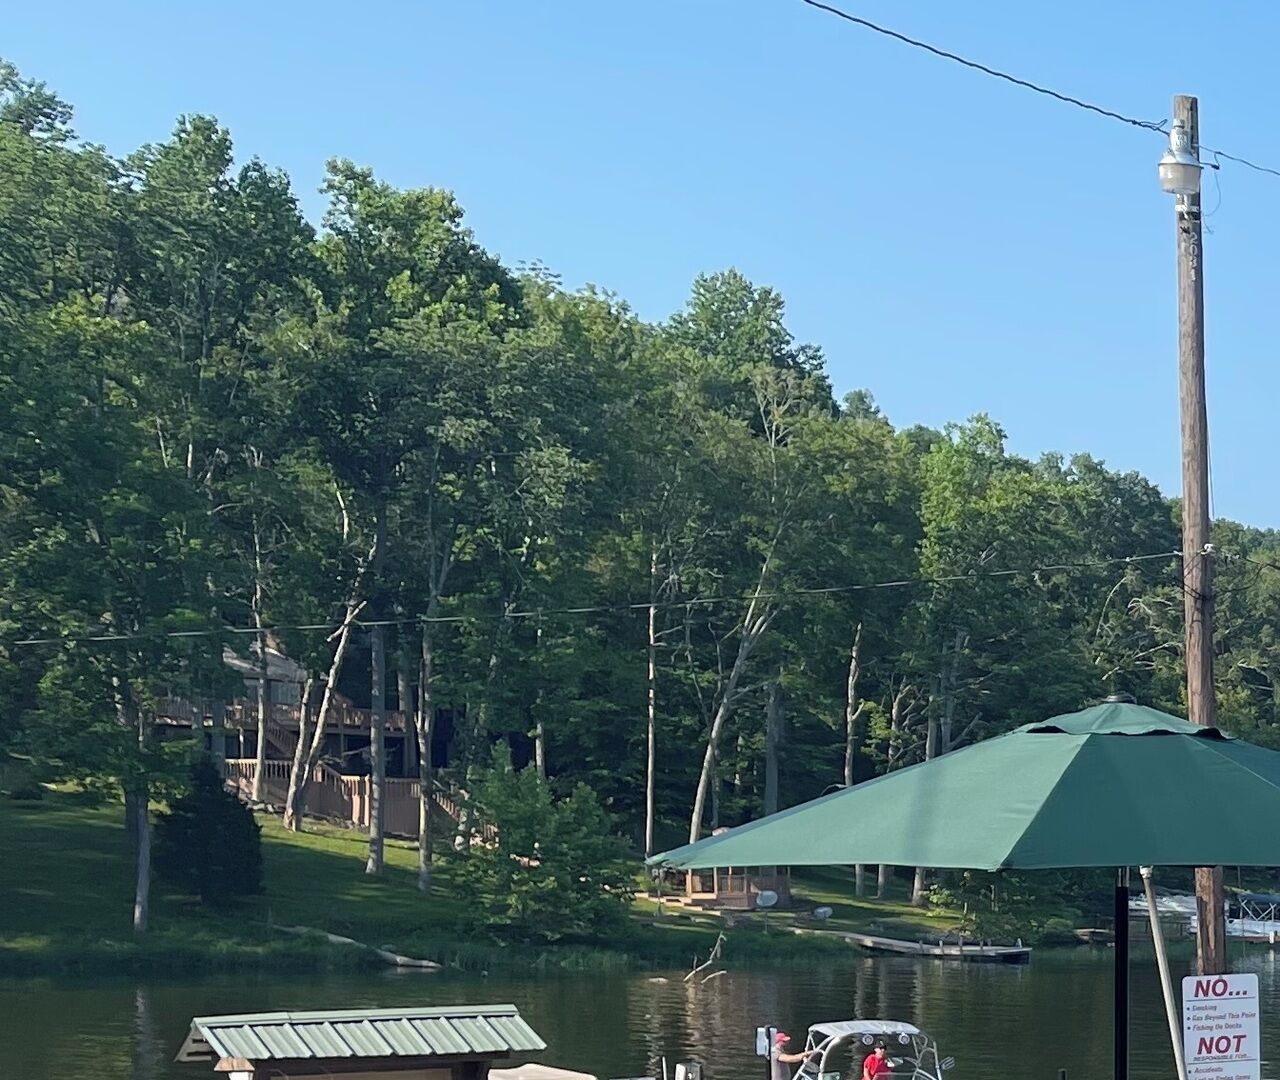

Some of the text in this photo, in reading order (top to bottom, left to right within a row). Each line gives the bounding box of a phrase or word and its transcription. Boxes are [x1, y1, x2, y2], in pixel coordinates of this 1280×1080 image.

[1194, 978, 1248, 998] NO...
[1192, 1023, 1214, 1032] Fishing
[1197, 1034, 1247, 1055] NOT
